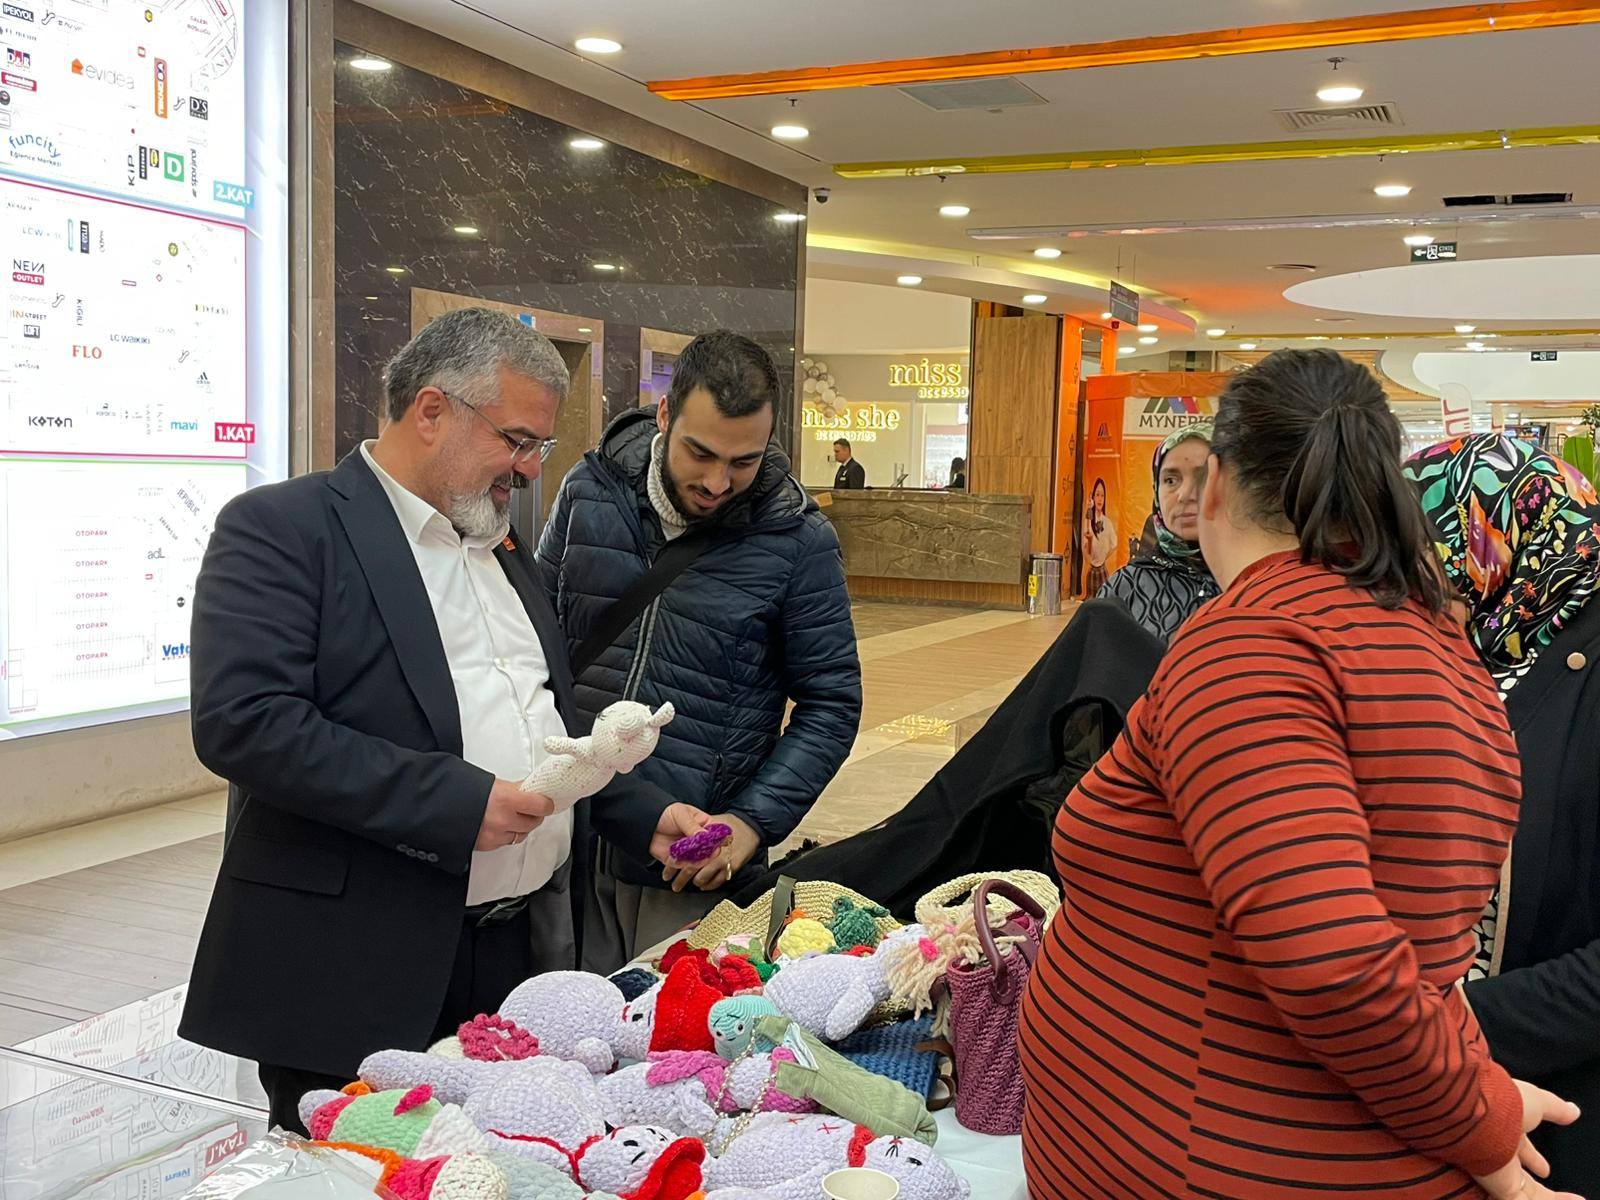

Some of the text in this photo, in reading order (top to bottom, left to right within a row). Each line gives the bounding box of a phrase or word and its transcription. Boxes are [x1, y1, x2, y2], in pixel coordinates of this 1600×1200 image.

[86, 65, 134, 88] evidea
[9, 134, 61, 158] funcity
[215, 184, 253, 205] 2.KAT
[72, 344, 102, 360] FLO
[889, 358, 962, 386] miss
[170, 418, 198, 431] mavi
[857, 404, 900, 430] she
[216, 426, 253, 442] 1.KAT
[75, 592, 108, 600] OTOPARK
[75, 622, 108, 630] OTOPARK
[75, 652, 108, 661] OTOPARK
